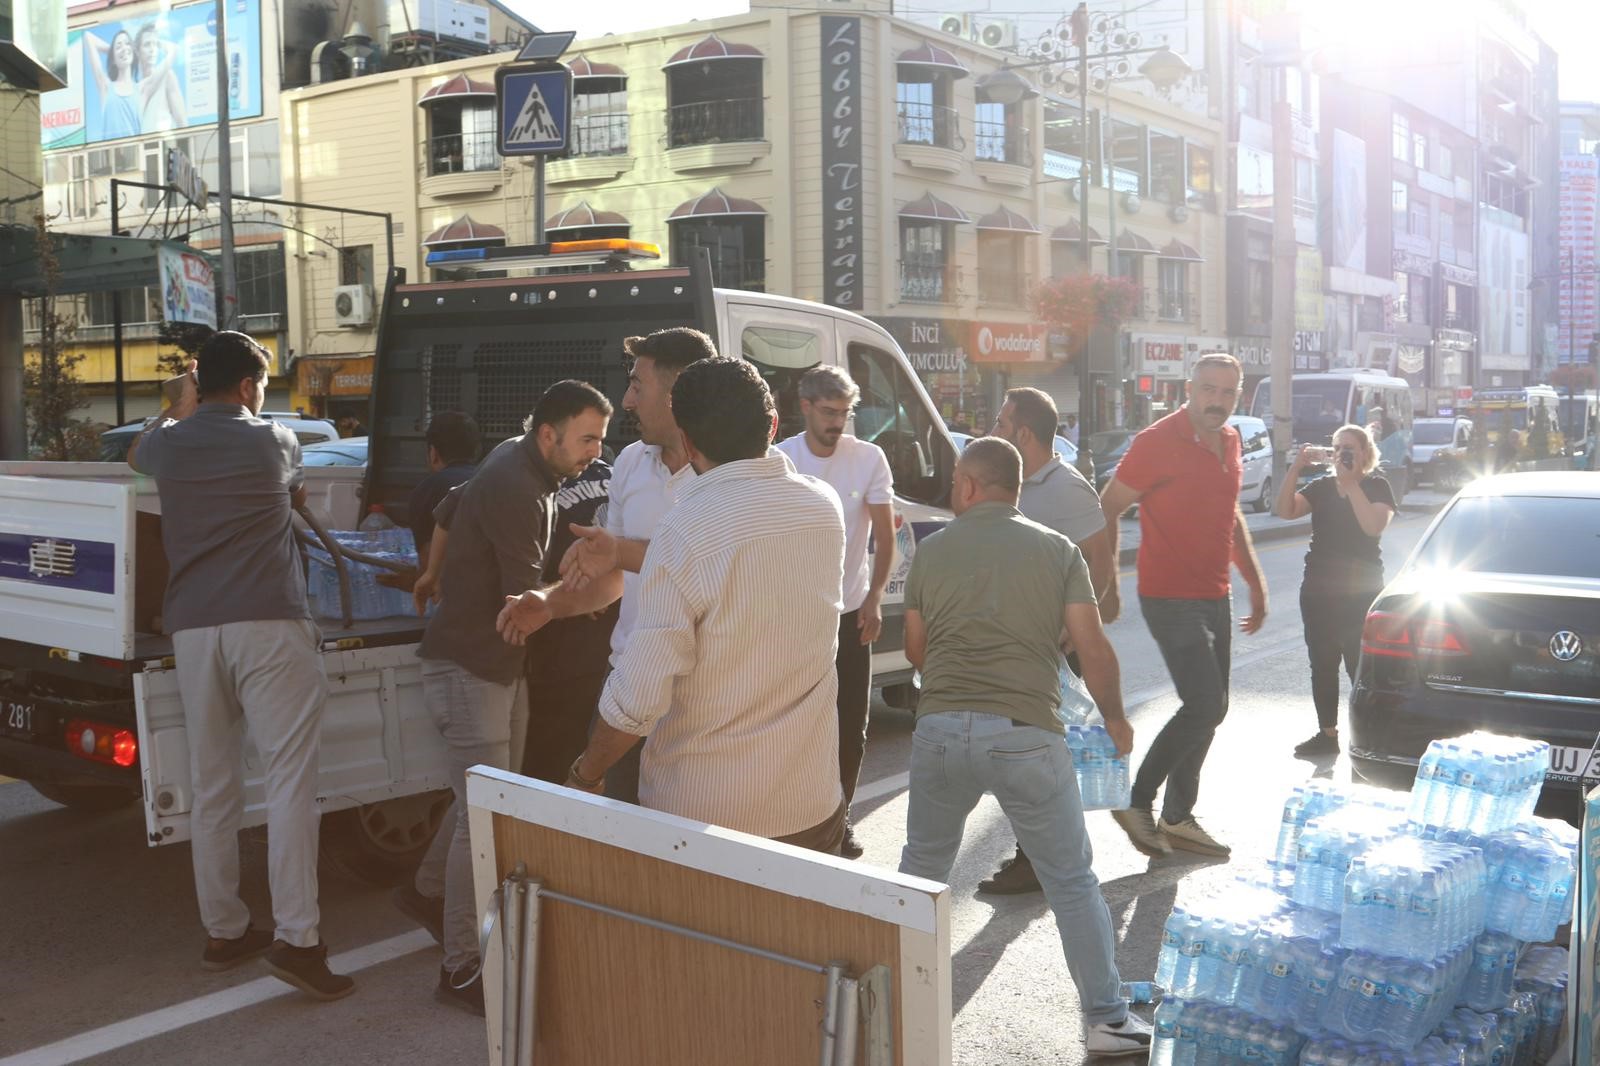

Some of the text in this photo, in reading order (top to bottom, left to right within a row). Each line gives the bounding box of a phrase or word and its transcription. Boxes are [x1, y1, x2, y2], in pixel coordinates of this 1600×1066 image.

[828, 163, 859, 305] Terrace
[911, 322, 939, 344] İNCİ
[994, 334, 1041, 352] vodafone
[1145, 342, 1183, 361] ECZANE
[907, 352, 968, 371] UMCULUK
[1427, 674, 1463, 682] PASSAT
[8, 703, 31, 731] 281
[1545, 774, 1578, 783] ERVICE
